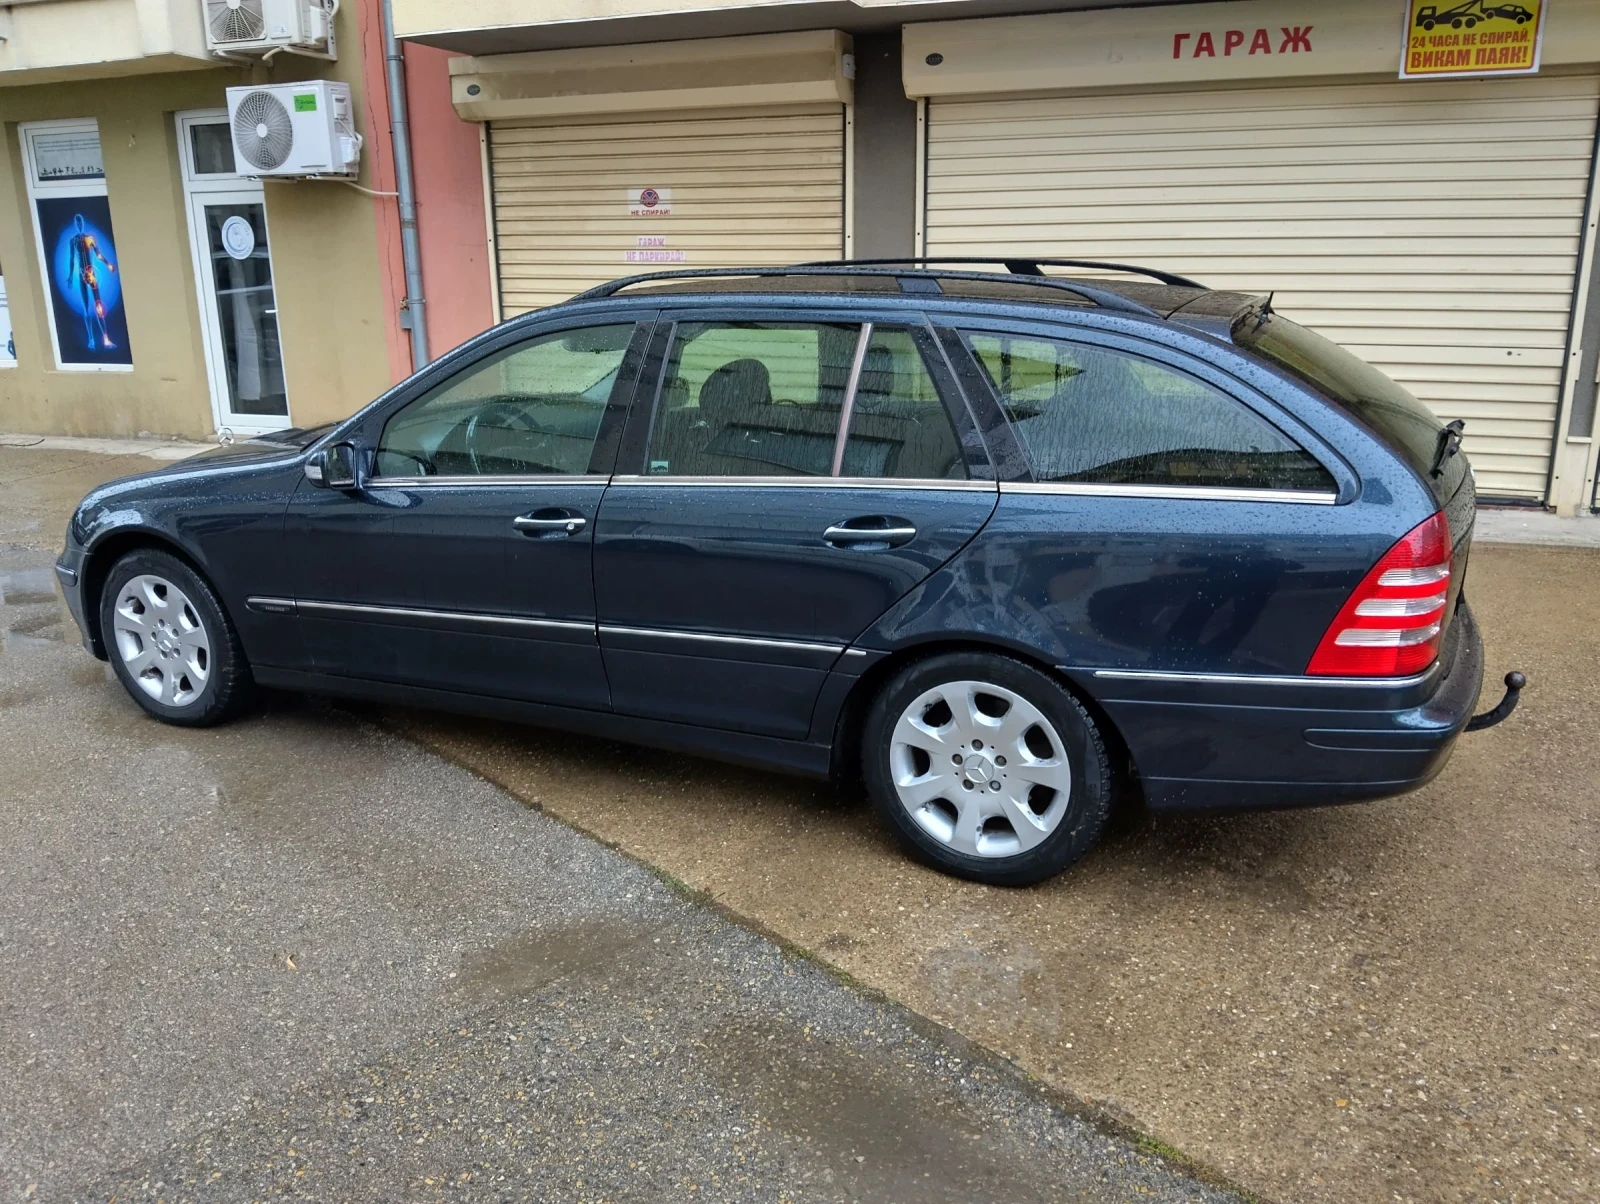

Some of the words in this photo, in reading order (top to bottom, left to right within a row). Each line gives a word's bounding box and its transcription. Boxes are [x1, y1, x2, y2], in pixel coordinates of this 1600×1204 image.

[1173, 26, 1314, 59] ГАРАЖ
[1411, 36, 1426, 49] 24
[1429, 33, 1460, 48] ЧАСА
[1462, 33, 1477, 46] НЕ
[1410, 48, 1472, 69] ВИКАМ
[1475, 45, 1529, 65] ПАЯК!
[641, 208, 671, 216] СПИРАЙ!
[638, 237, 665, 247] ГАРАЖ
[626, 251, 637, 262] НЕ
[638, 249, 684, 262] ПАРКИРАЙ!
